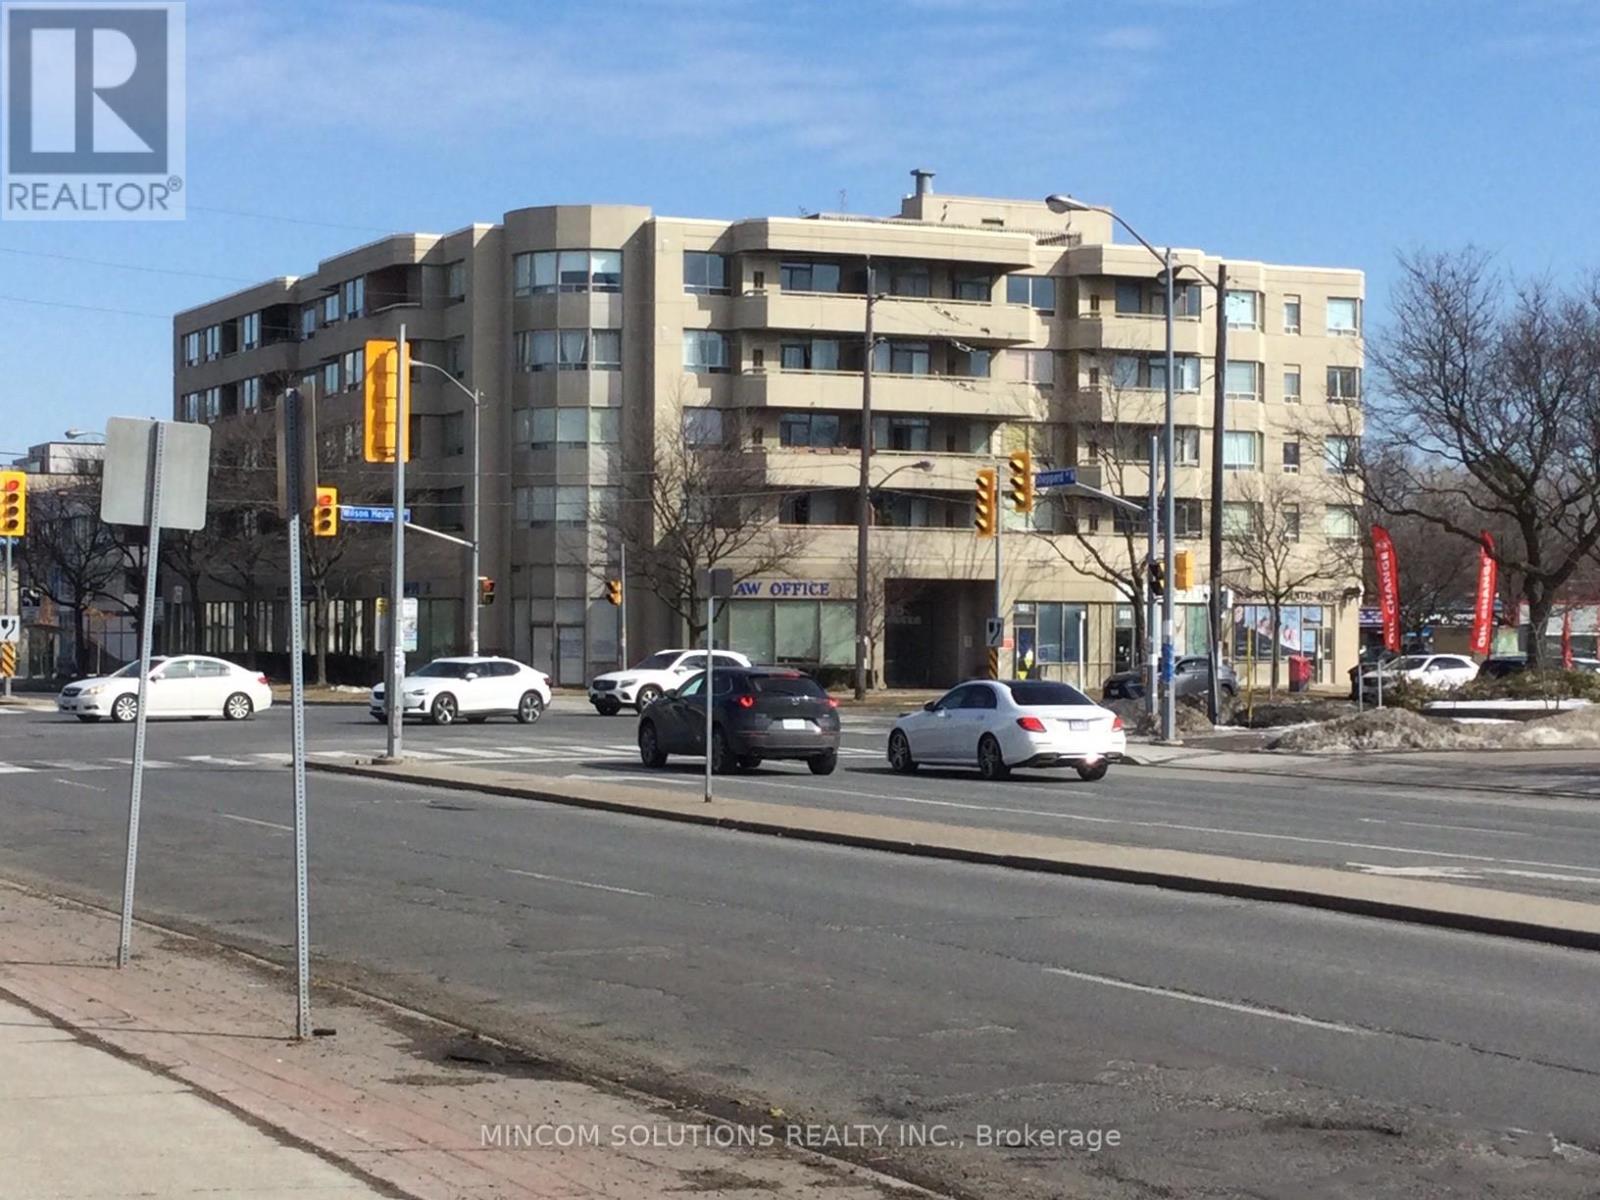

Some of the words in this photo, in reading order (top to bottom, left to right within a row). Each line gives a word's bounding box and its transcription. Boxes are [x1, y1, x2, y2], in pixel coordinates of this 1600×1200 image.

[734, 582, 762, 596] AW
[769, 582, 830, 596] OFFICE
[1380, 551, 1396, 615] CHANGE
[1388, 618, 1396, 645] OIL
[1477, 622, 1488, 648] OIL
